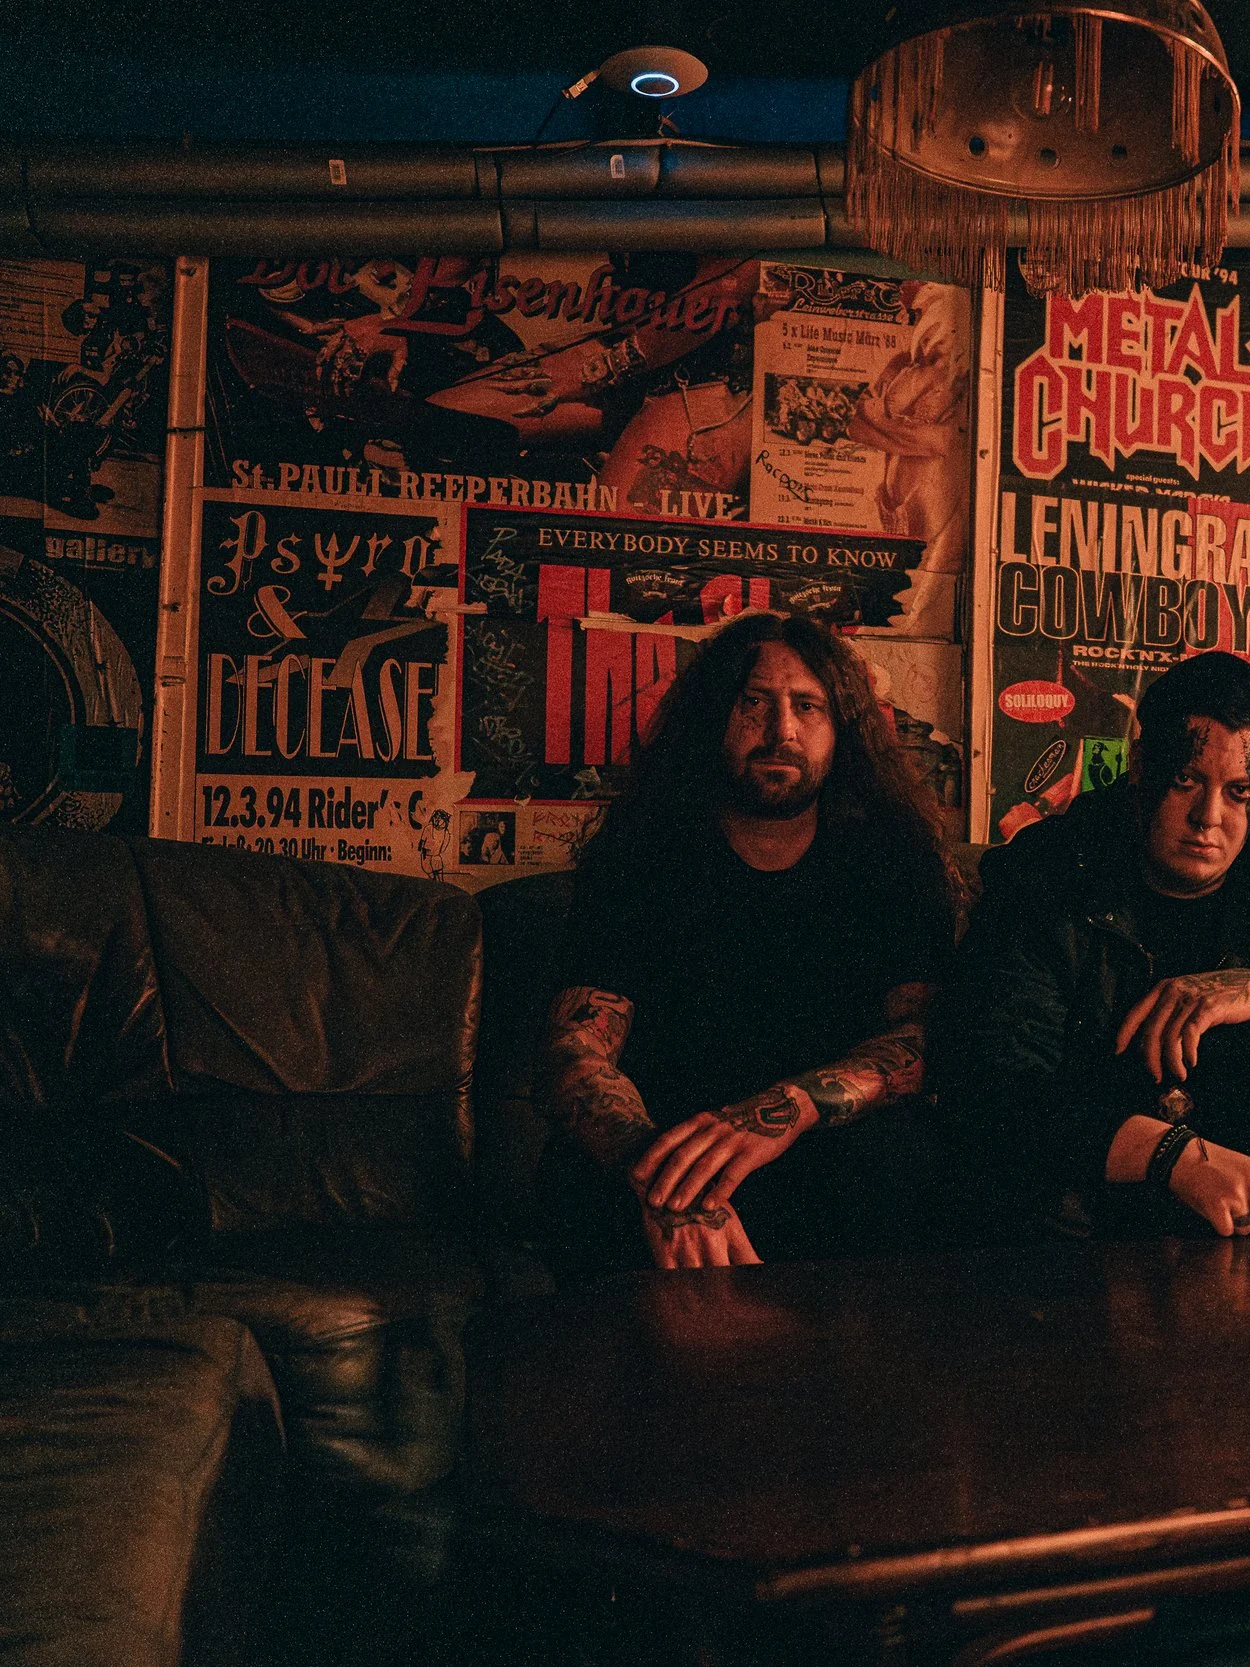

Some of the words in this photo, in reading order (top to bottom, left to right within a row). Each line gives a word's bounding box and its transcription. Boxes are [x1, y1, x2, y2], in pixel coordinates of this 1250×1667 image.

[399, 471, 618, 512] REEPERBAHN
[538, 527, 690, 558] EVERYBODY
[698, 538, 779, 563] SEEMS
[788, 545, 819, 565] TO
[827, 547, 898, 570] KNOW
[247, 585, 307, 638] &
[205, 653, 440, 762] DECEASE
[1004, 693, 1068, 710] SOLILOQUY
[203, 785, 301, 828] 12.3.94
[338, 840, 392, 865] Beginn:
